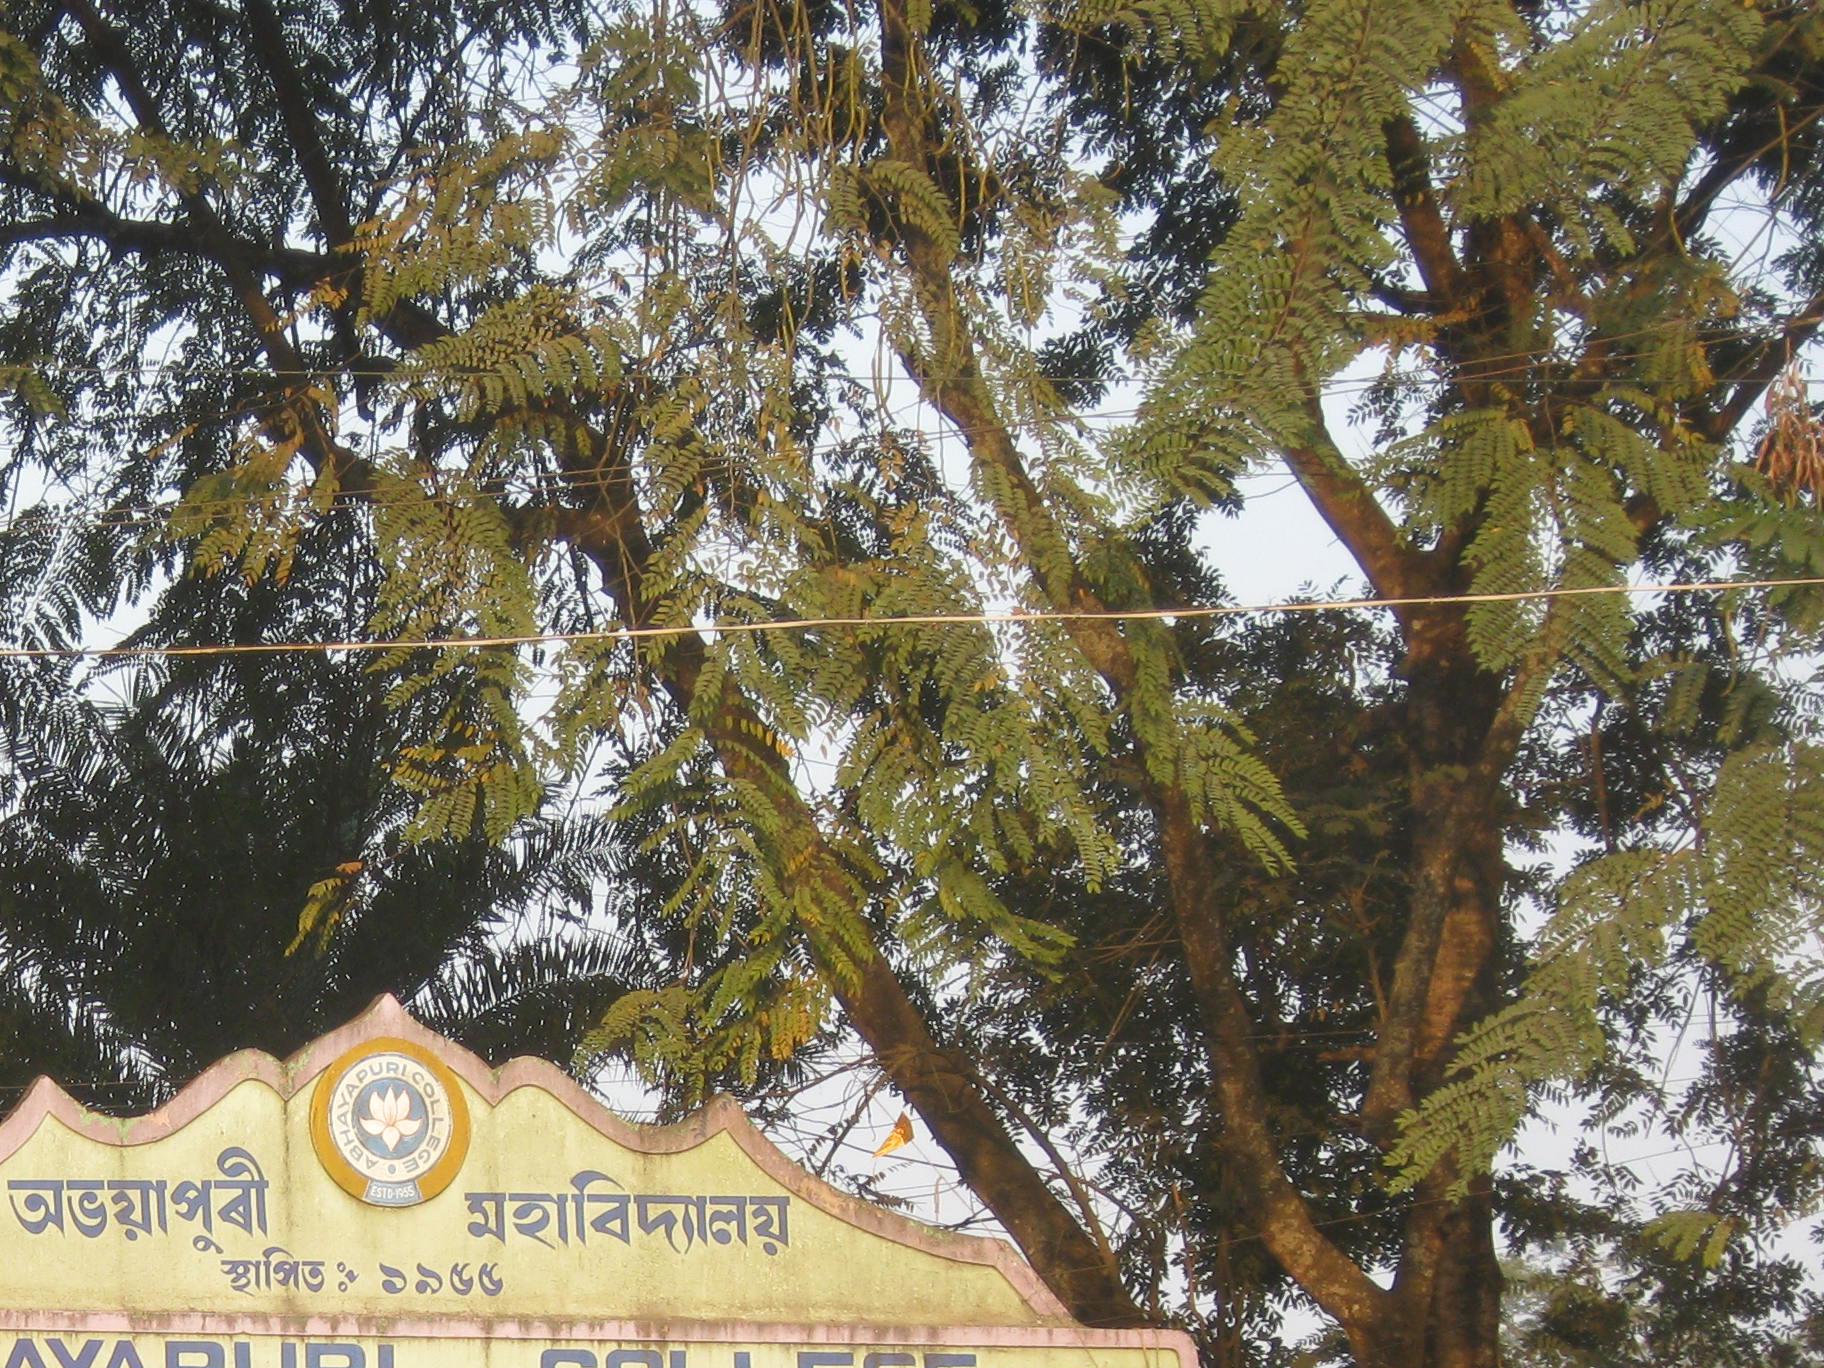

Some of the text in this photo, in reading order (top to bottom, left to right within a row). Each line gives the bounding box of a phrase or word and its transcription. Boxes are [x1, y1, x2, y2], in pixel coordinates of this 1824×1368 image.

[336, 1061, 444, 1174] ABHAYAPURI COLLEGE
[7, 1146, 791, 1257] অভয়াপুৰী মহাবিদ্যালয়
[379, 1261, 504, 1297] ১৯৫৫
